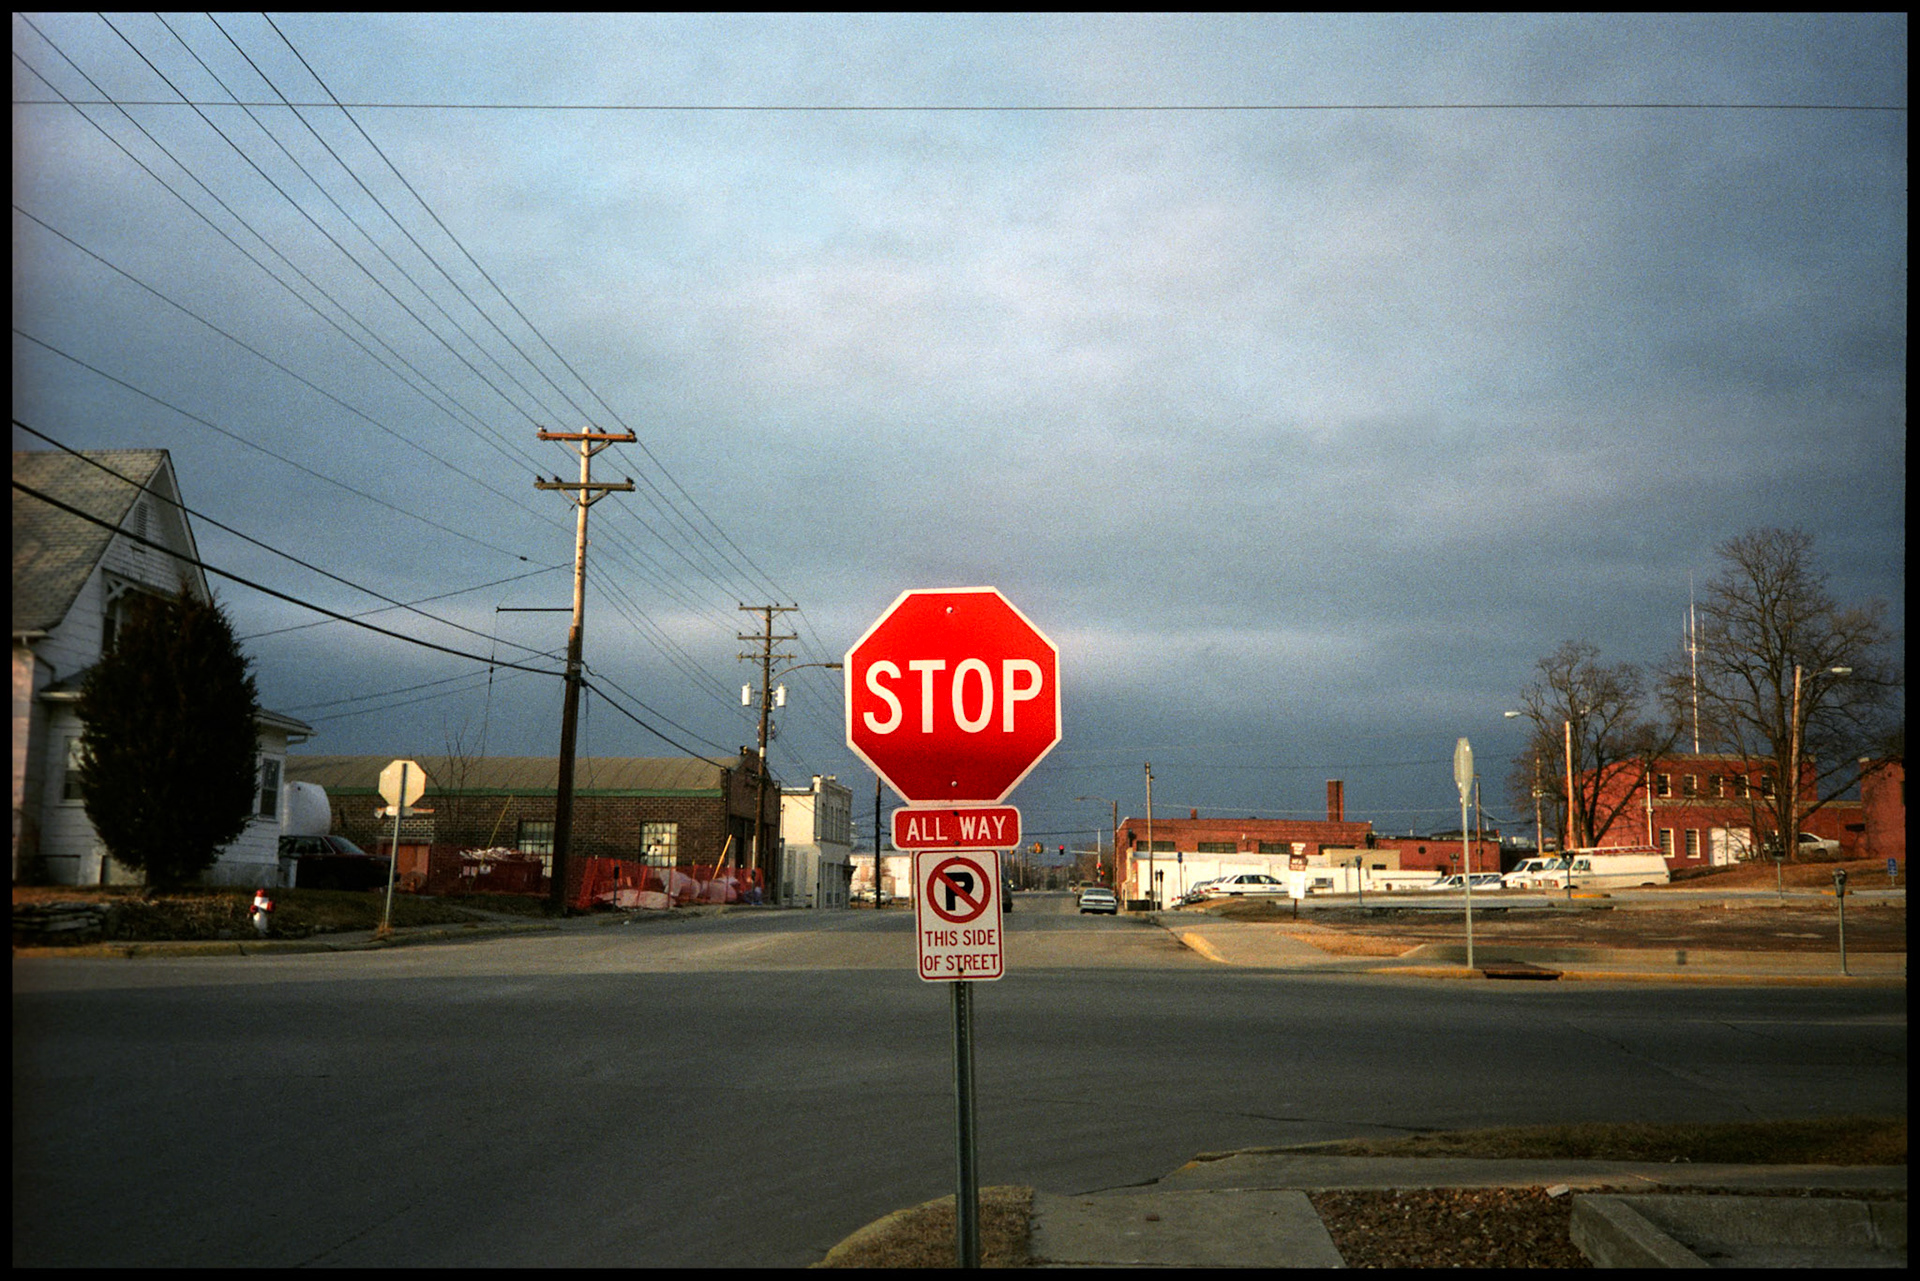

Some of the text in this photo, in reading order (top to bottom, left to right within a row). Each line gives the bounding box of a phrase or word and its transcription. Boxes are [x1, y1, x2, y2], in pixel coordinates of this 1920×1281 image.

[863, 657, 1043, 734] STOP
[906, 815, 1006, 841] ALL WAY
[924, 929, 996, 947] THIS SIDE
[923, 953, 999, 972] OF STREET
